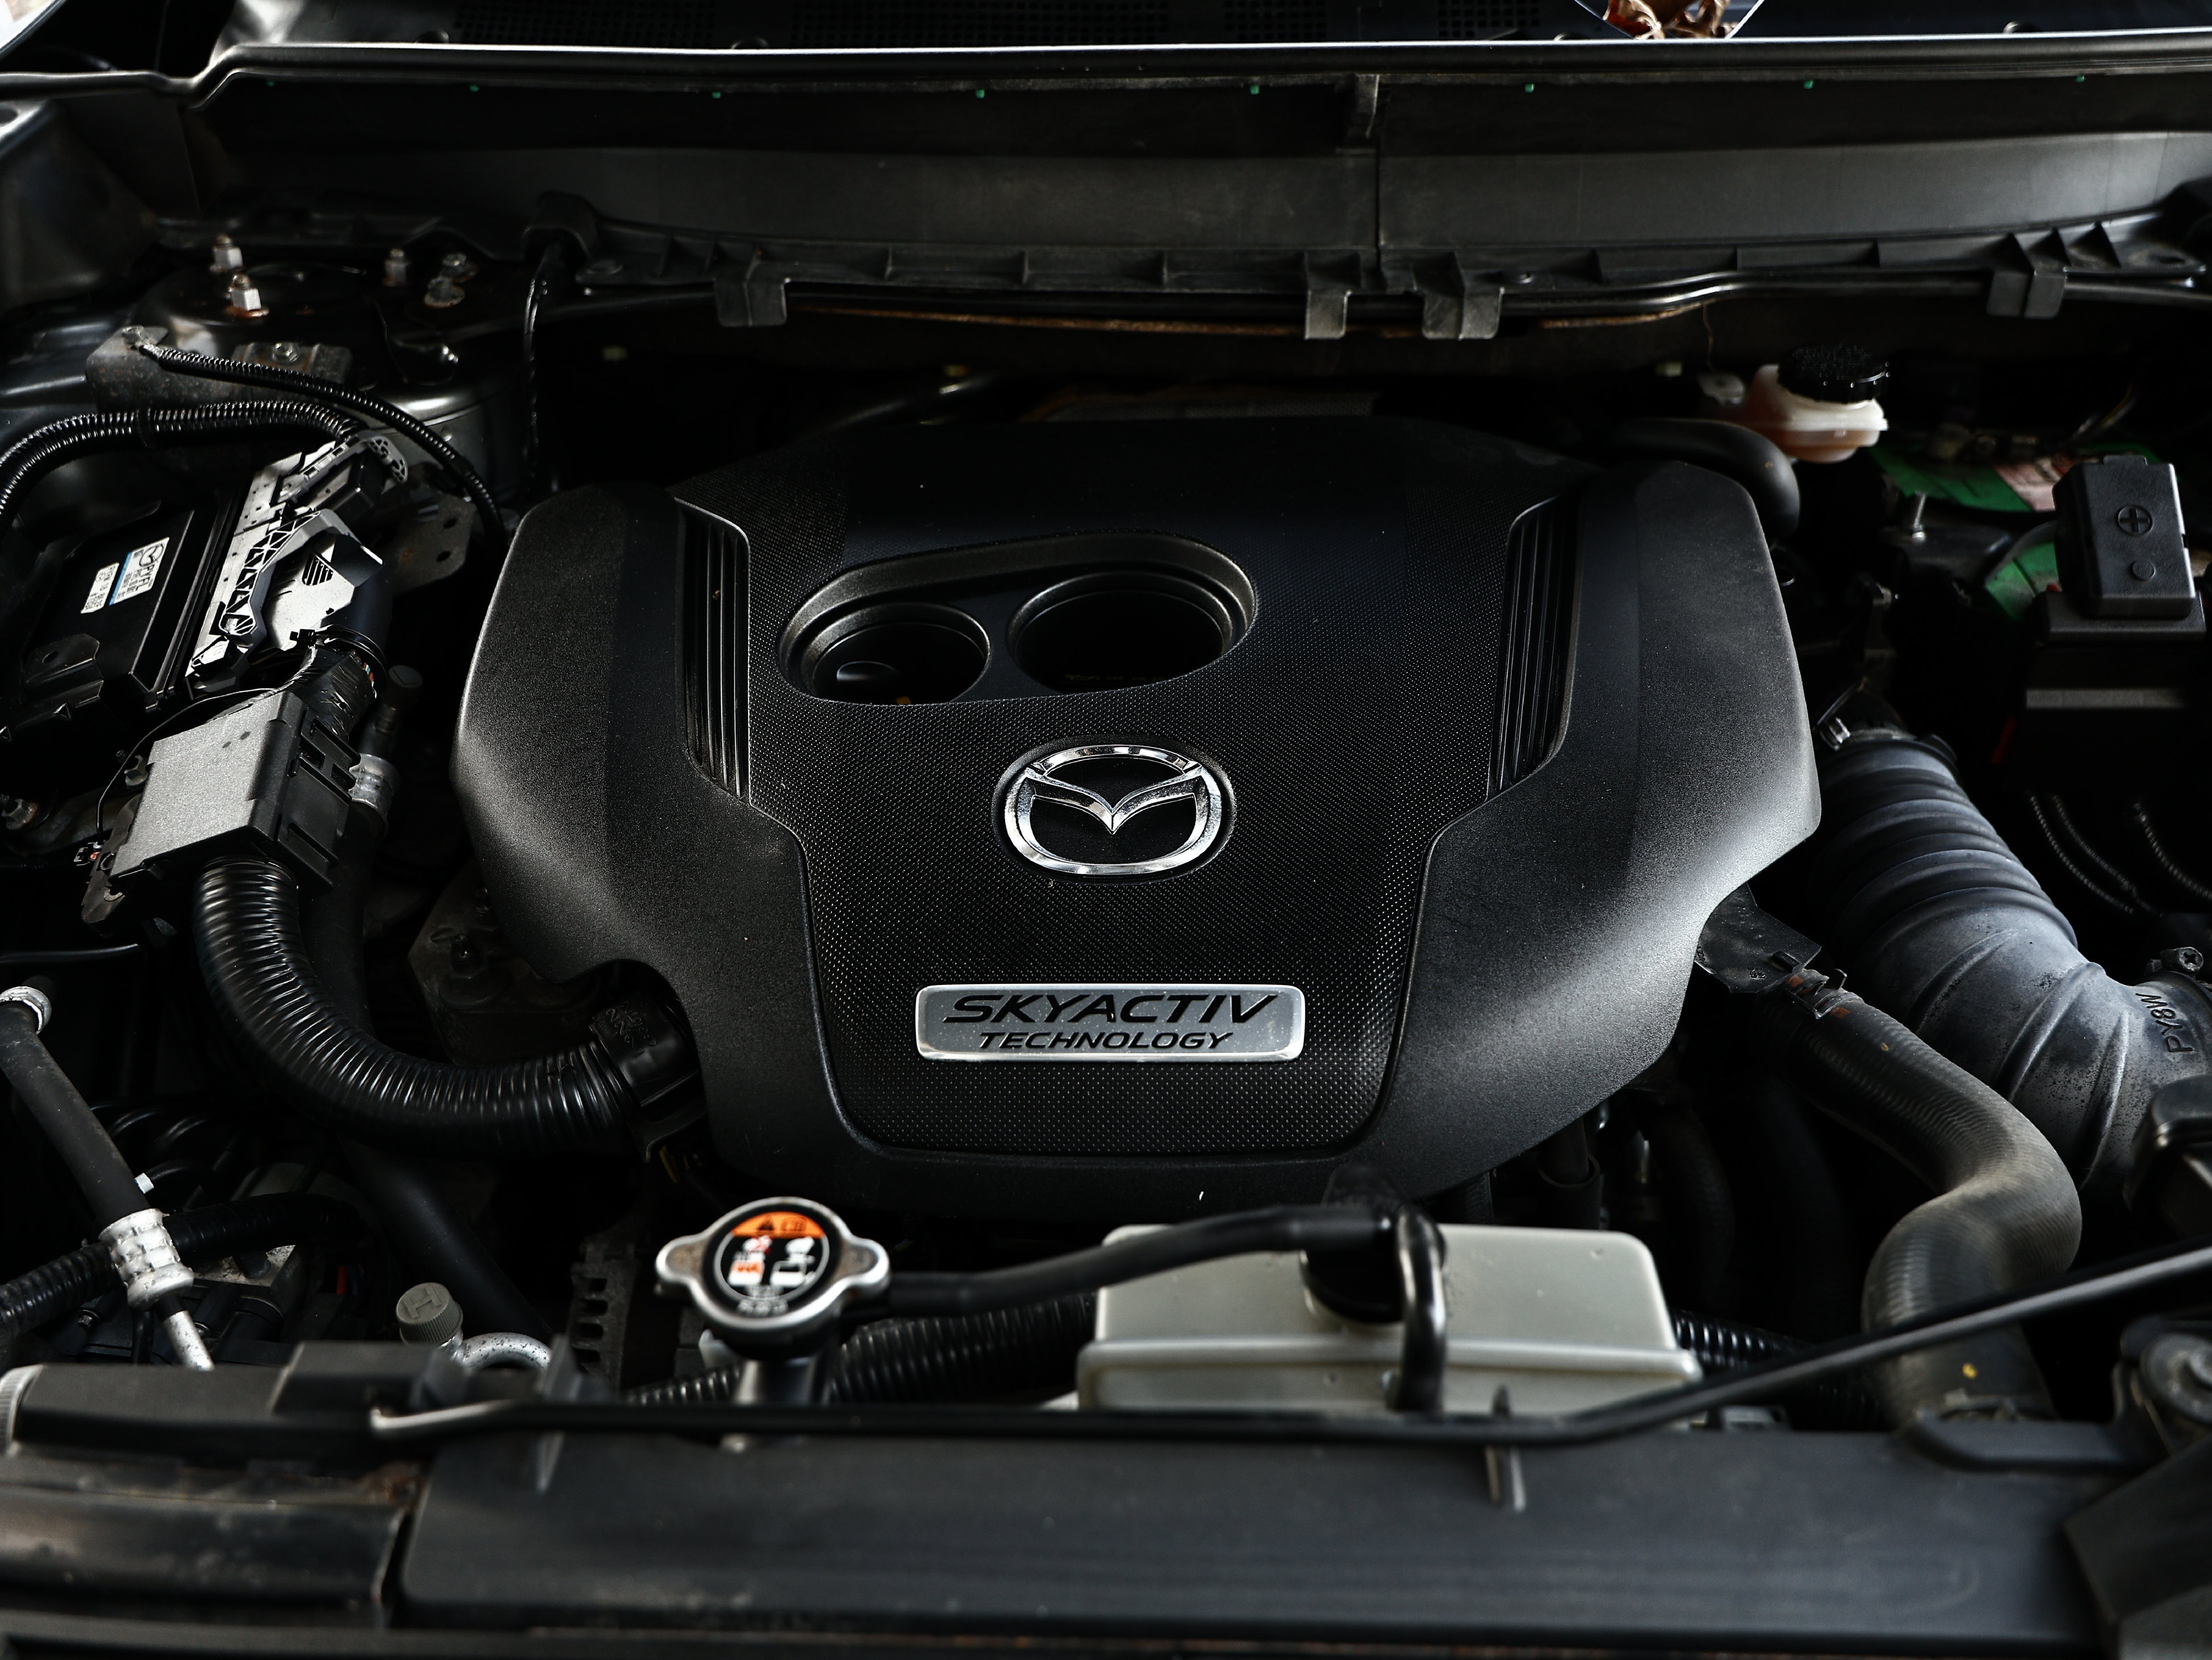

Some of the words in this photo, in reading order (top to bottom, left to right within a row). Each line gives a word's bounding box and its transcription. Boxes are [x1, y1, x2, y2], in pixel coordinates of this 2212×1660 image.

[942, 994, 1278, 1024] SKYACTIV
[2135, 993, 2194, 1052] PY8W
[979, 1031, 1233, 1049] TECHNOLOGY
